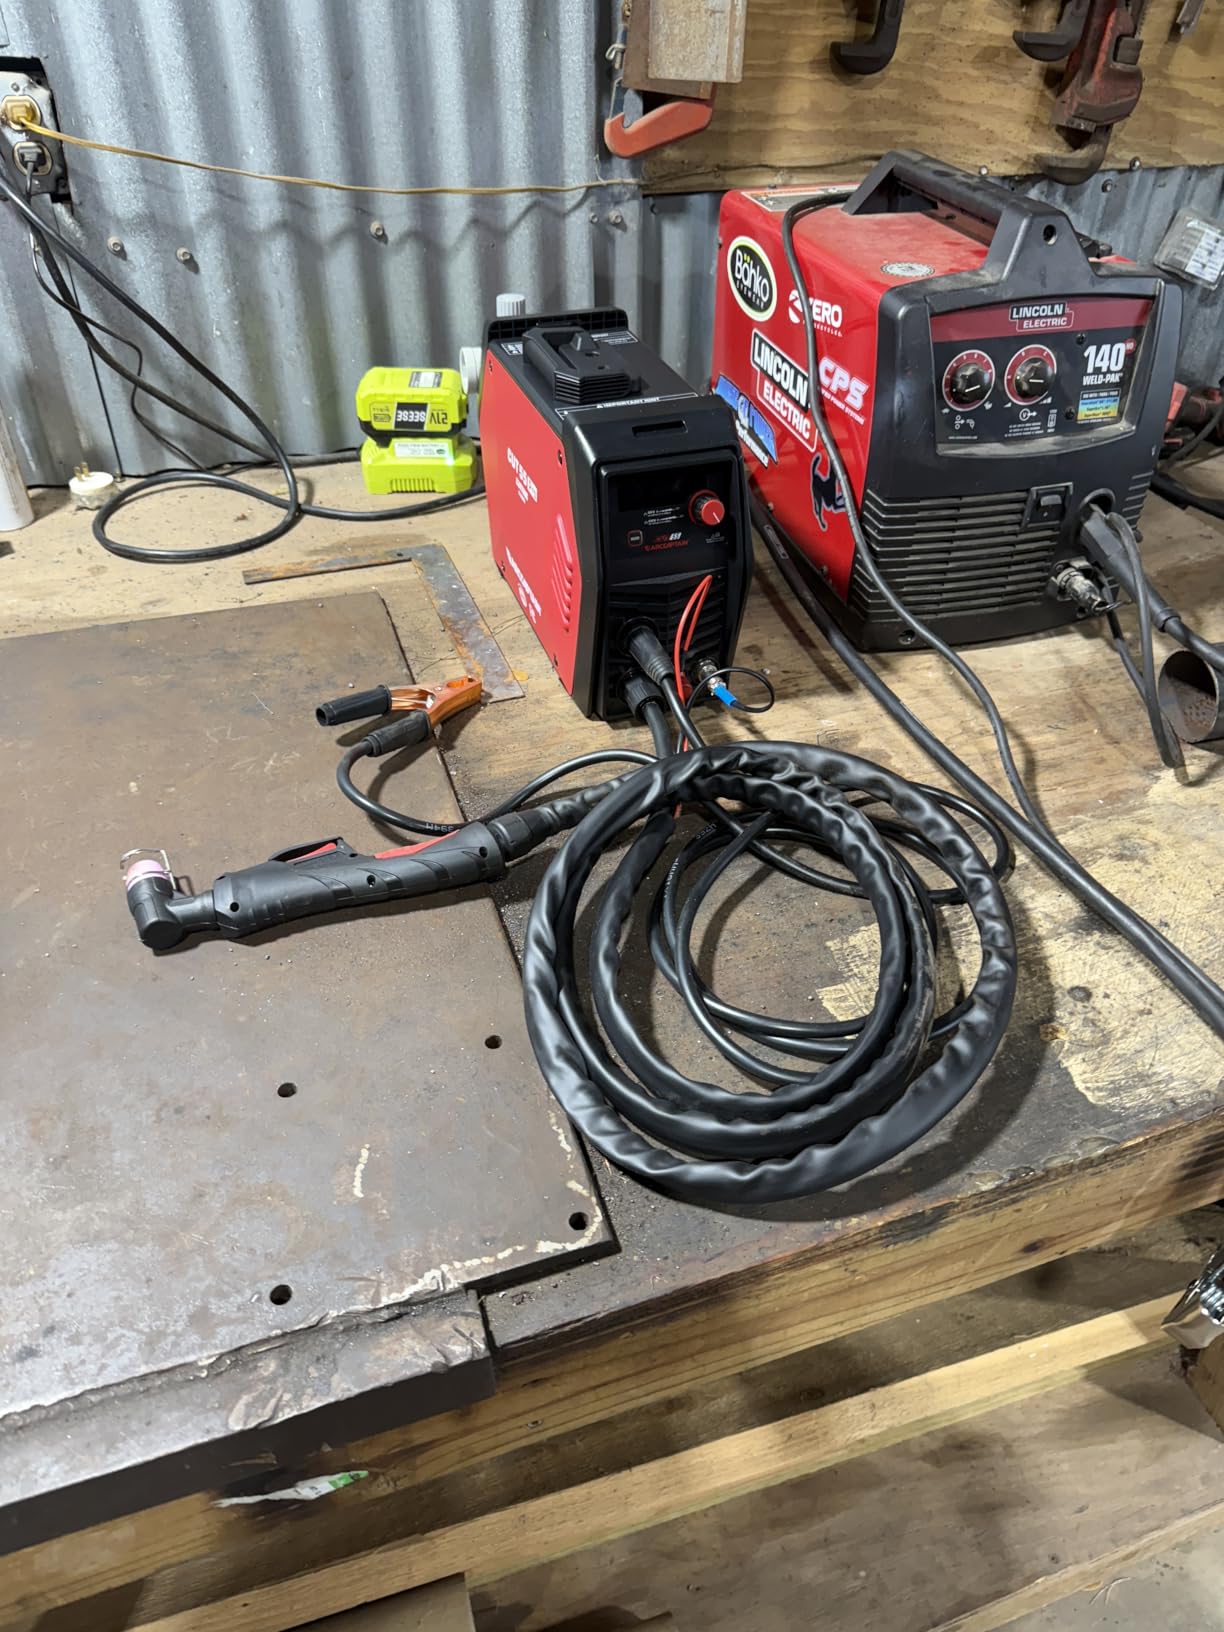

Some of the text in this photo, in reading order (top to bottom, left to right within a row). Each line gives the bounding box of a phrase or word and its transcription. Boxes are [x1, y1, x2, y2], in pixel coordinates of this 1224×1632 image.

[1012, 304, 1064, 319] LINCOLN
[1023, 317, 1068, 329] ELECTRIC
[1083, 342, 1126, 374] 140
[753, 337, 809, 408] LINCOLN
[818, 356, 869, 411] CPS
[1082, 373, 1121, 386] WELD-PAK
[430, 412, 448, 424] 21V
[763, 380, 812, 440] ELECTRIC
